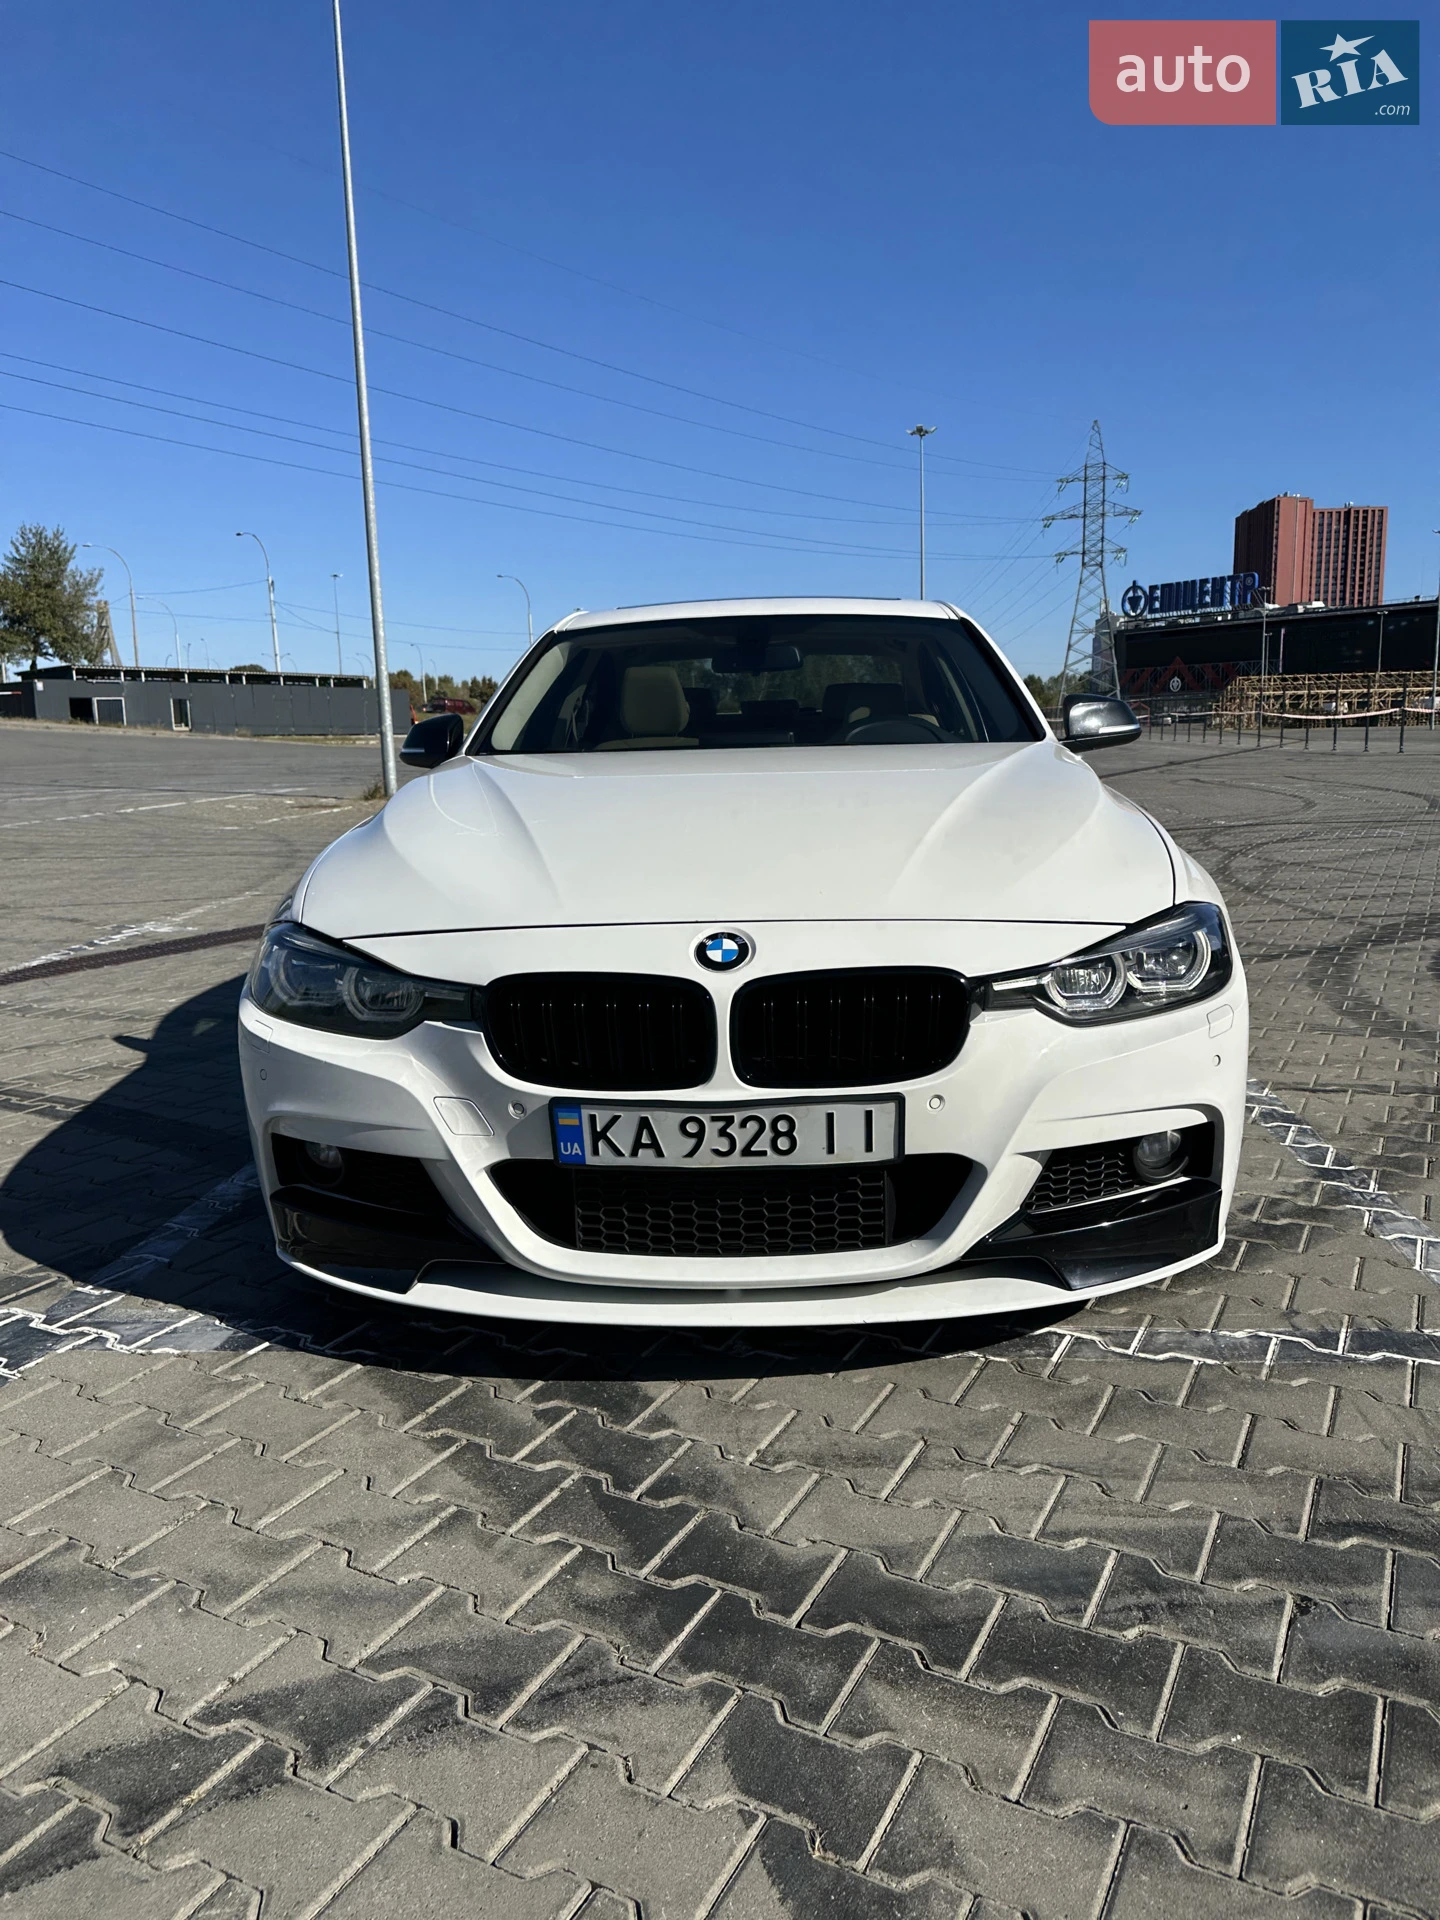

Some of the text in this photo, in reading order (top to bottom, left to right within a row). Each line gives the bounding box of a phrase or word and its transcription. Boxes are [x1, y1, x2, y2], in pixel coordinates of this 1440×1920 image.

[561, 1142, 583, 1156] UA
[588, 1113, 665, 1158] KA
[679, 1113, 798, 1158] 9328
